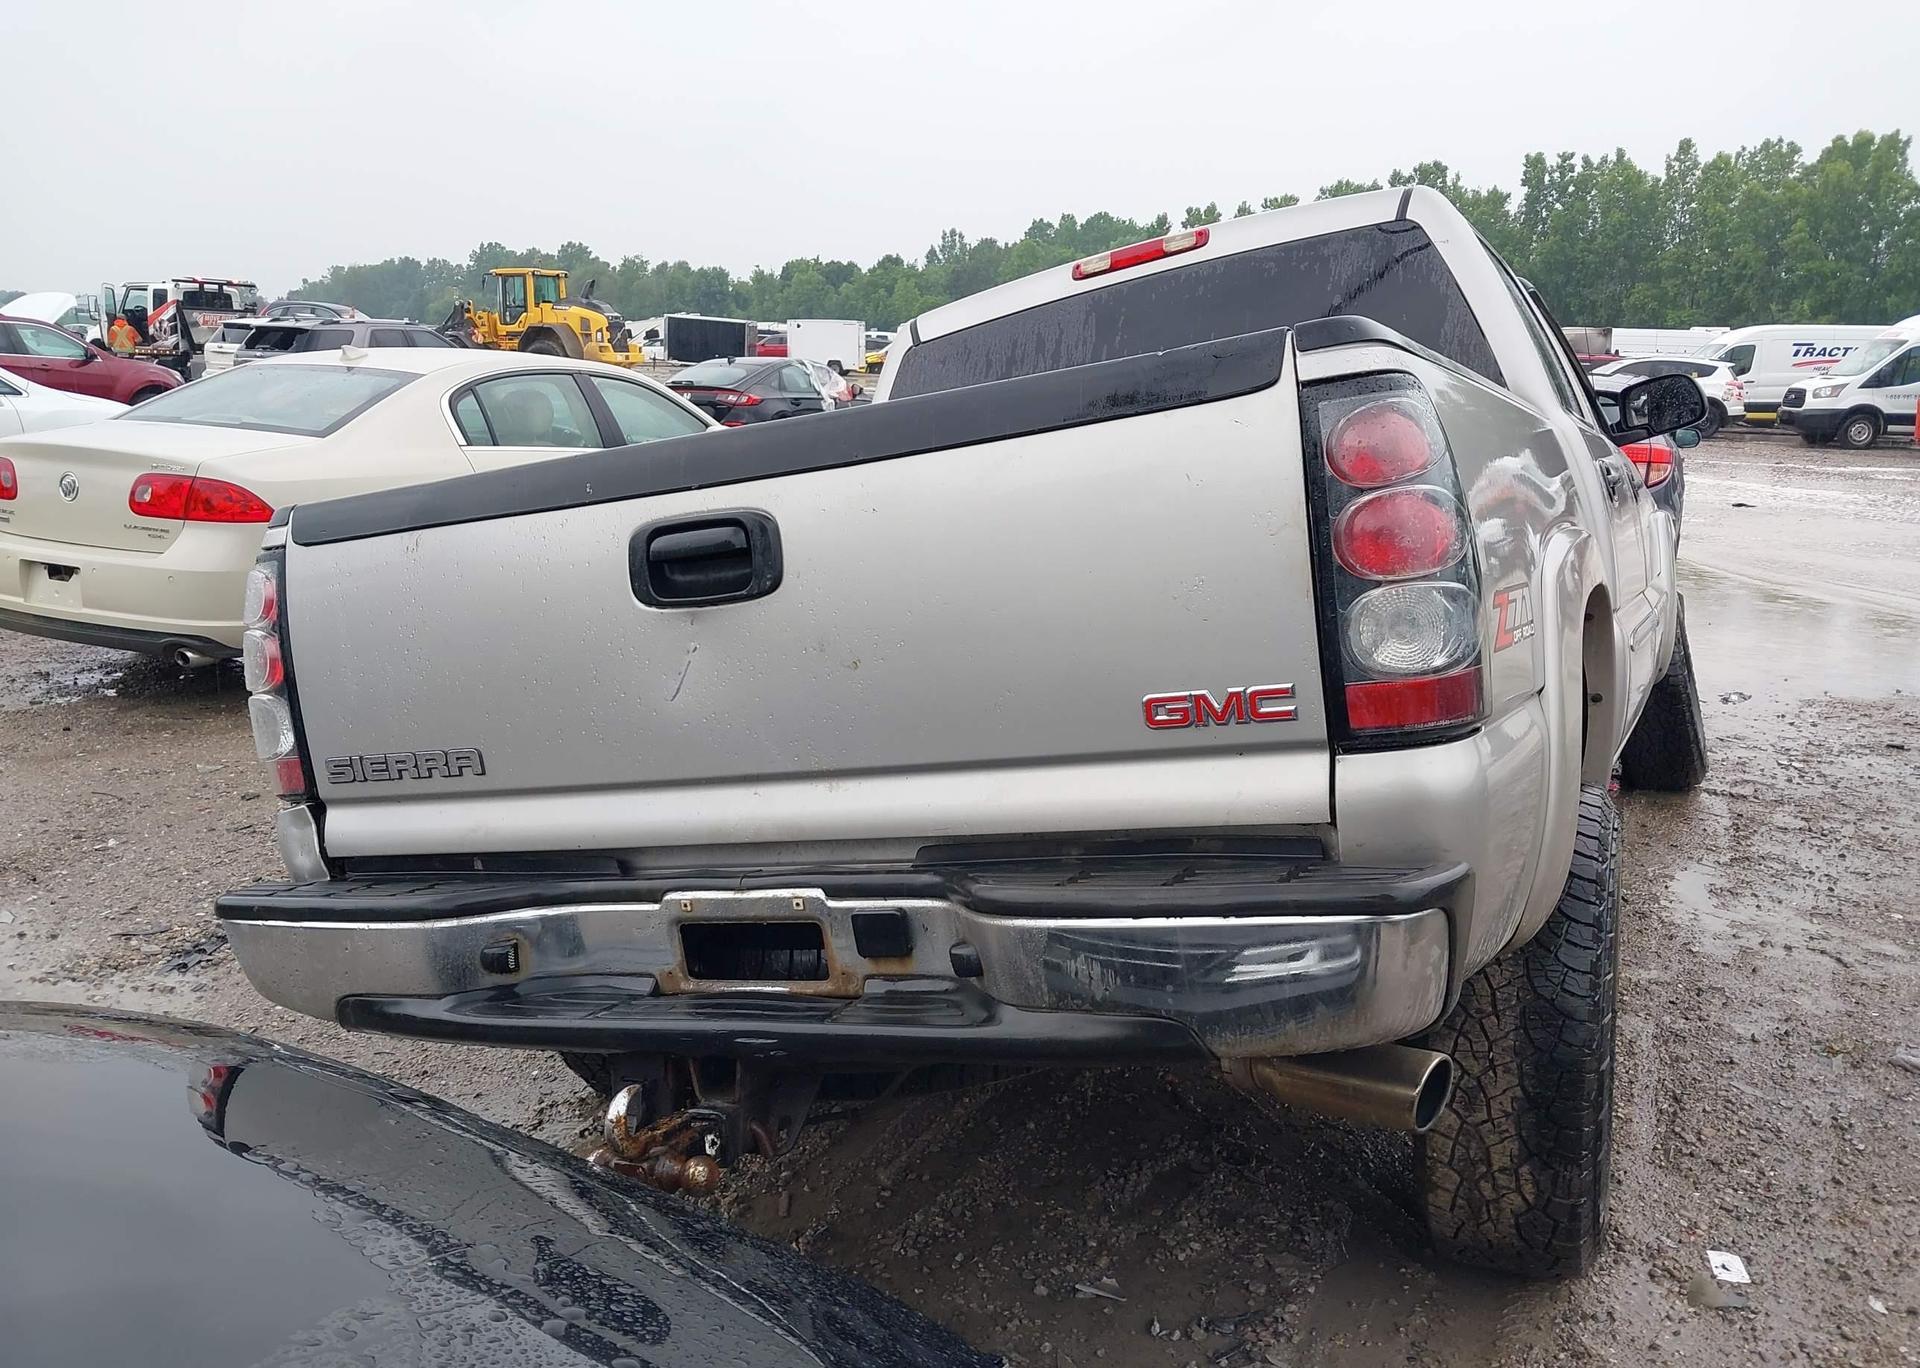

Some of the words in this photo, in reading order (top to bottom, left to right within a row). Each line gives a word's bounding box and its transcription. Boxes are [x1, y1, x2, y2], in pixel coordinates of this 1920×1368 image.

[1792, 343, 1858, 357] TRACT
[1143, 682, 1298, 729] GMC
[325, 748, 486, 784] SIERRA
